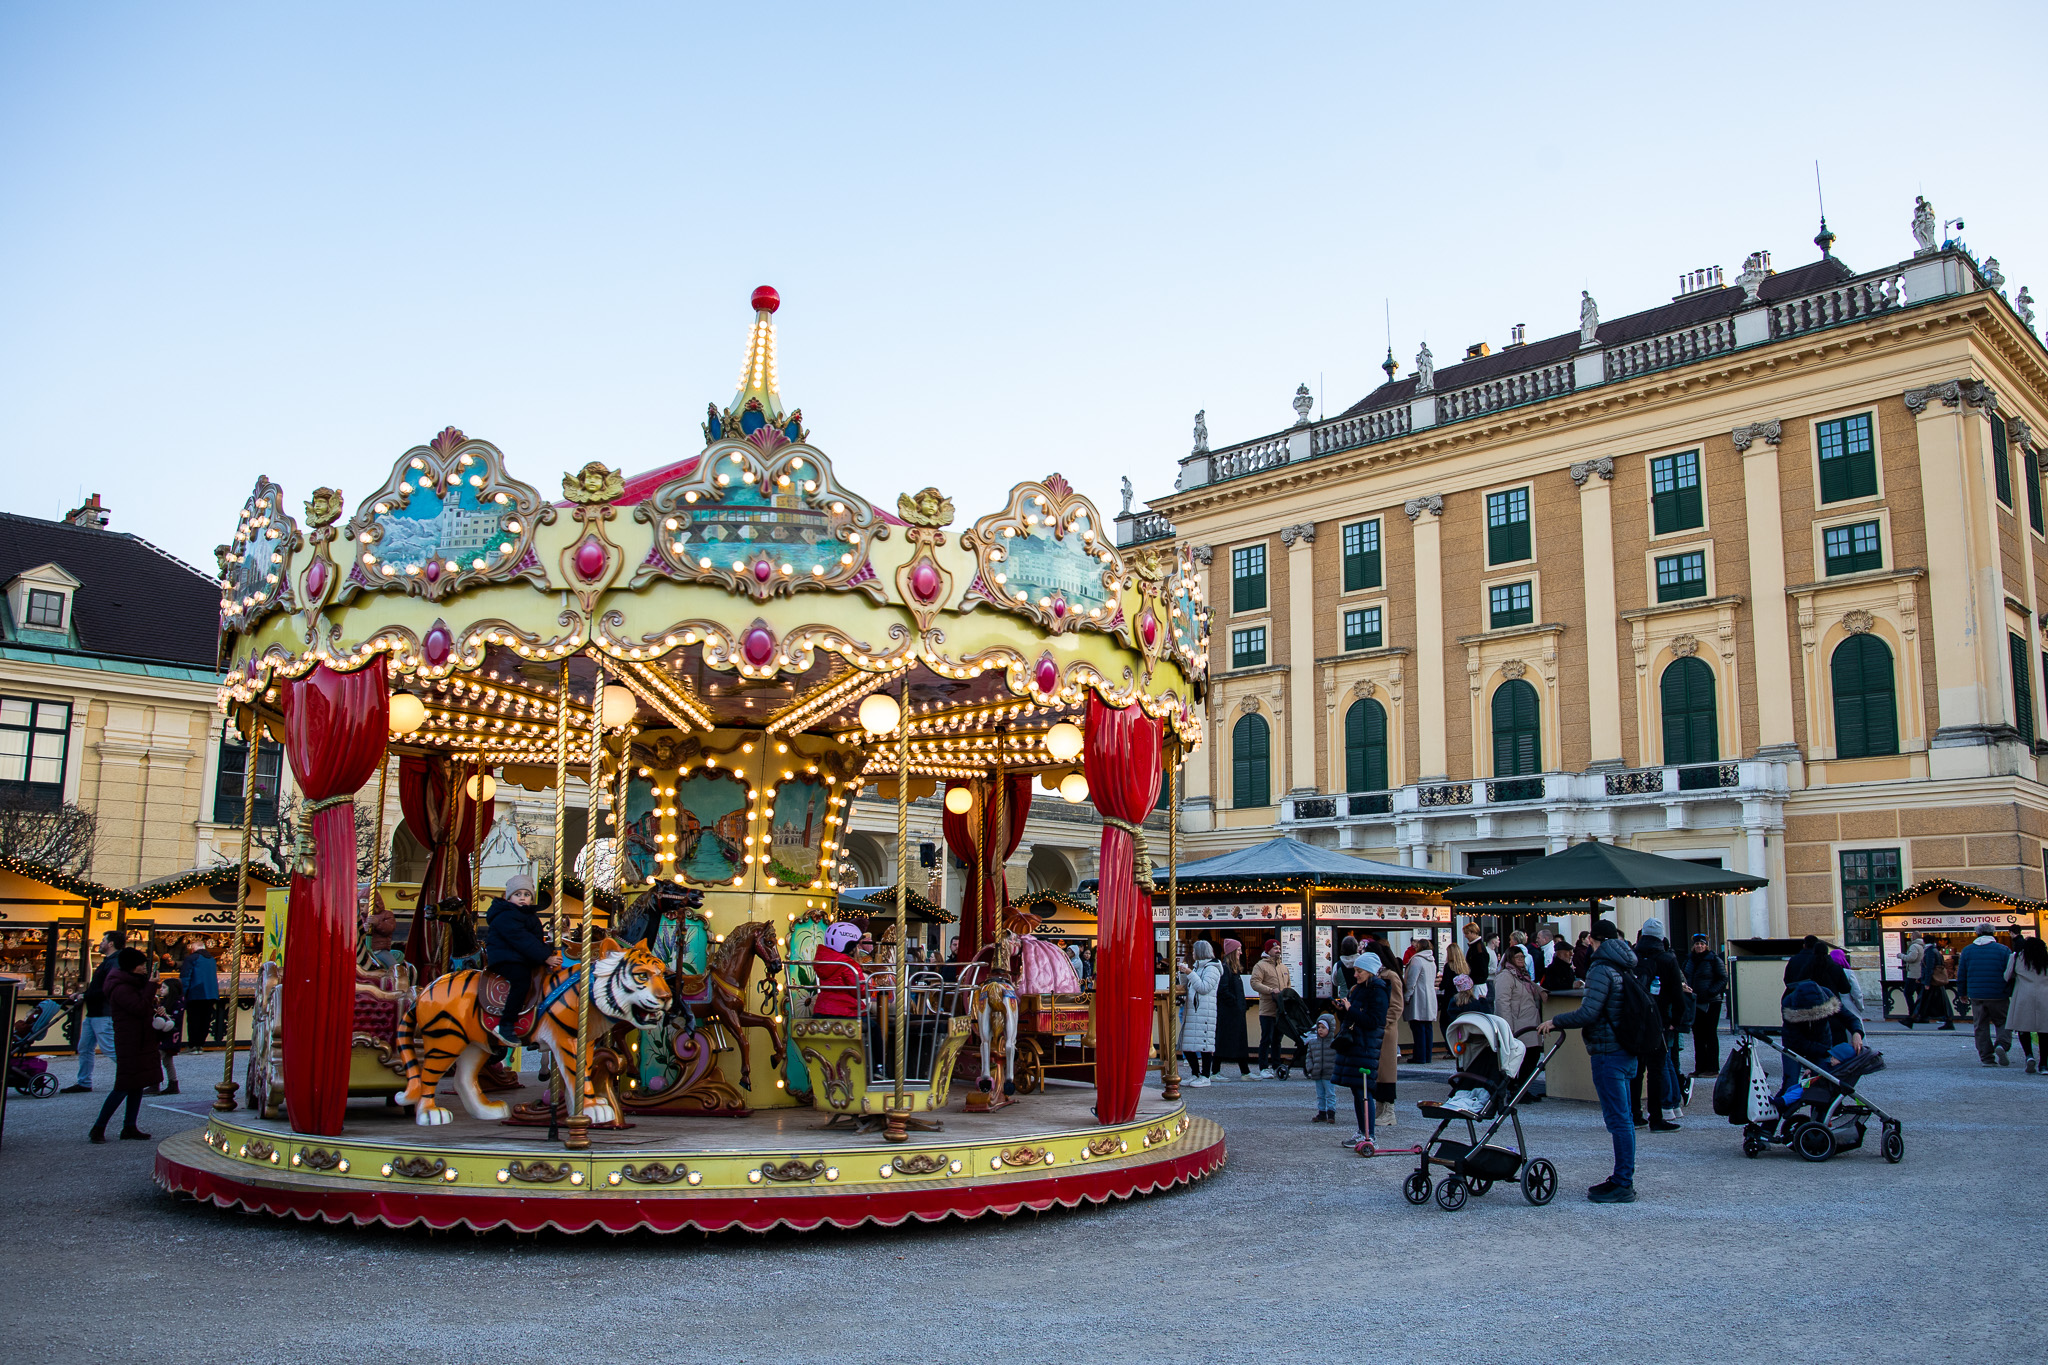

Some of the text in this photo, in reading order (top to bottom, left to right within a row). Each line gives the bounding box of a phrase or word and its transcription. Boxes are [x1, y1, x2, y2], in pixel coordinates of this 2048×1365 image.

[1322, 904, 1339, 914] BOSNA
[1340, 905, 1350, 914] HOT
[1351, 906, 1361, 915] DOG
[1912, 915, 2001, 925] BREZEN BOUTIQUE
